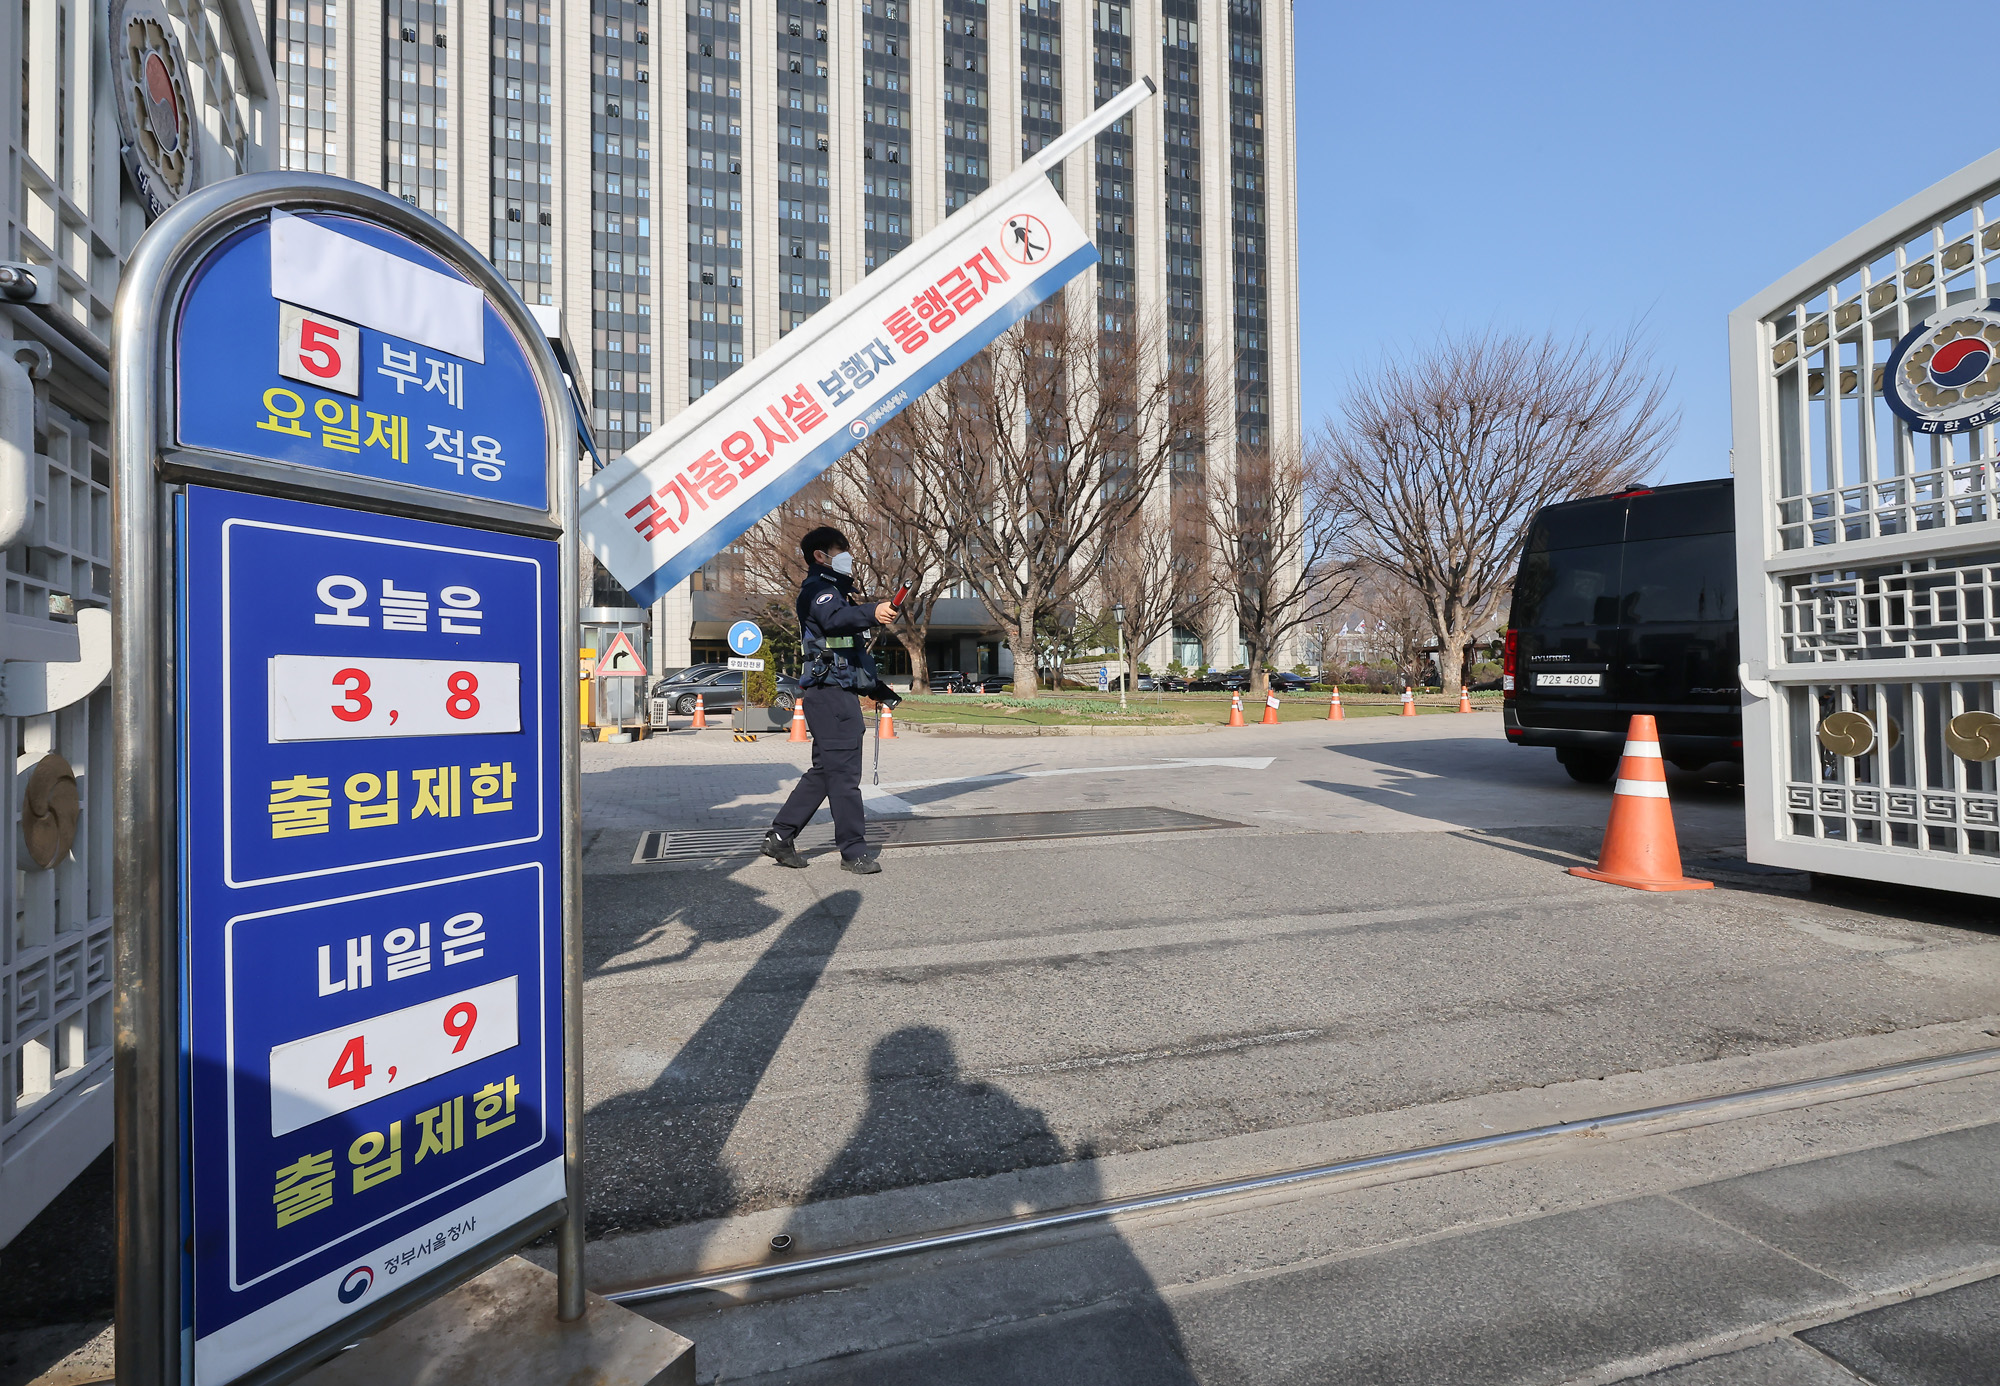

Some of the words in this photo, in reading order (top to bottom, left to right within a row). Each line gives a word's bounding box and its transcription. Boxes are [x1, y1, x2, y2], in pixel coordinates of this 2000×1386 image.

[299, 318, 342, 379] 5
[377, 342, 465, 410] 부제
[624, 382, 829, 542] 국가중요시설
[817, 337, 897, 408] 보행자
[882, 245, 1011, 354] 통행금지
[256, 386, 410, 464] 요일제
[424, 423, 506, 482] 적용
[314, 574, 483, 635] 오늘은
[331, 667, 399, 726] 3,
[445, 670, 481, 720] 8
[1531, 654, 1571, 662] HYUNDAI
[1566, 675, 1594, 685] 4806
[267, 761, 517, 839] 출입제한
[317, 911, 486, 998] 내일은
[327, 1034, 398, 1091] 4,
[443, 1001, 478, 1055] 9
[272, 1074, 520, 1230] 출입제한
[383, 1215, 477, 1275] 정부서울청사
